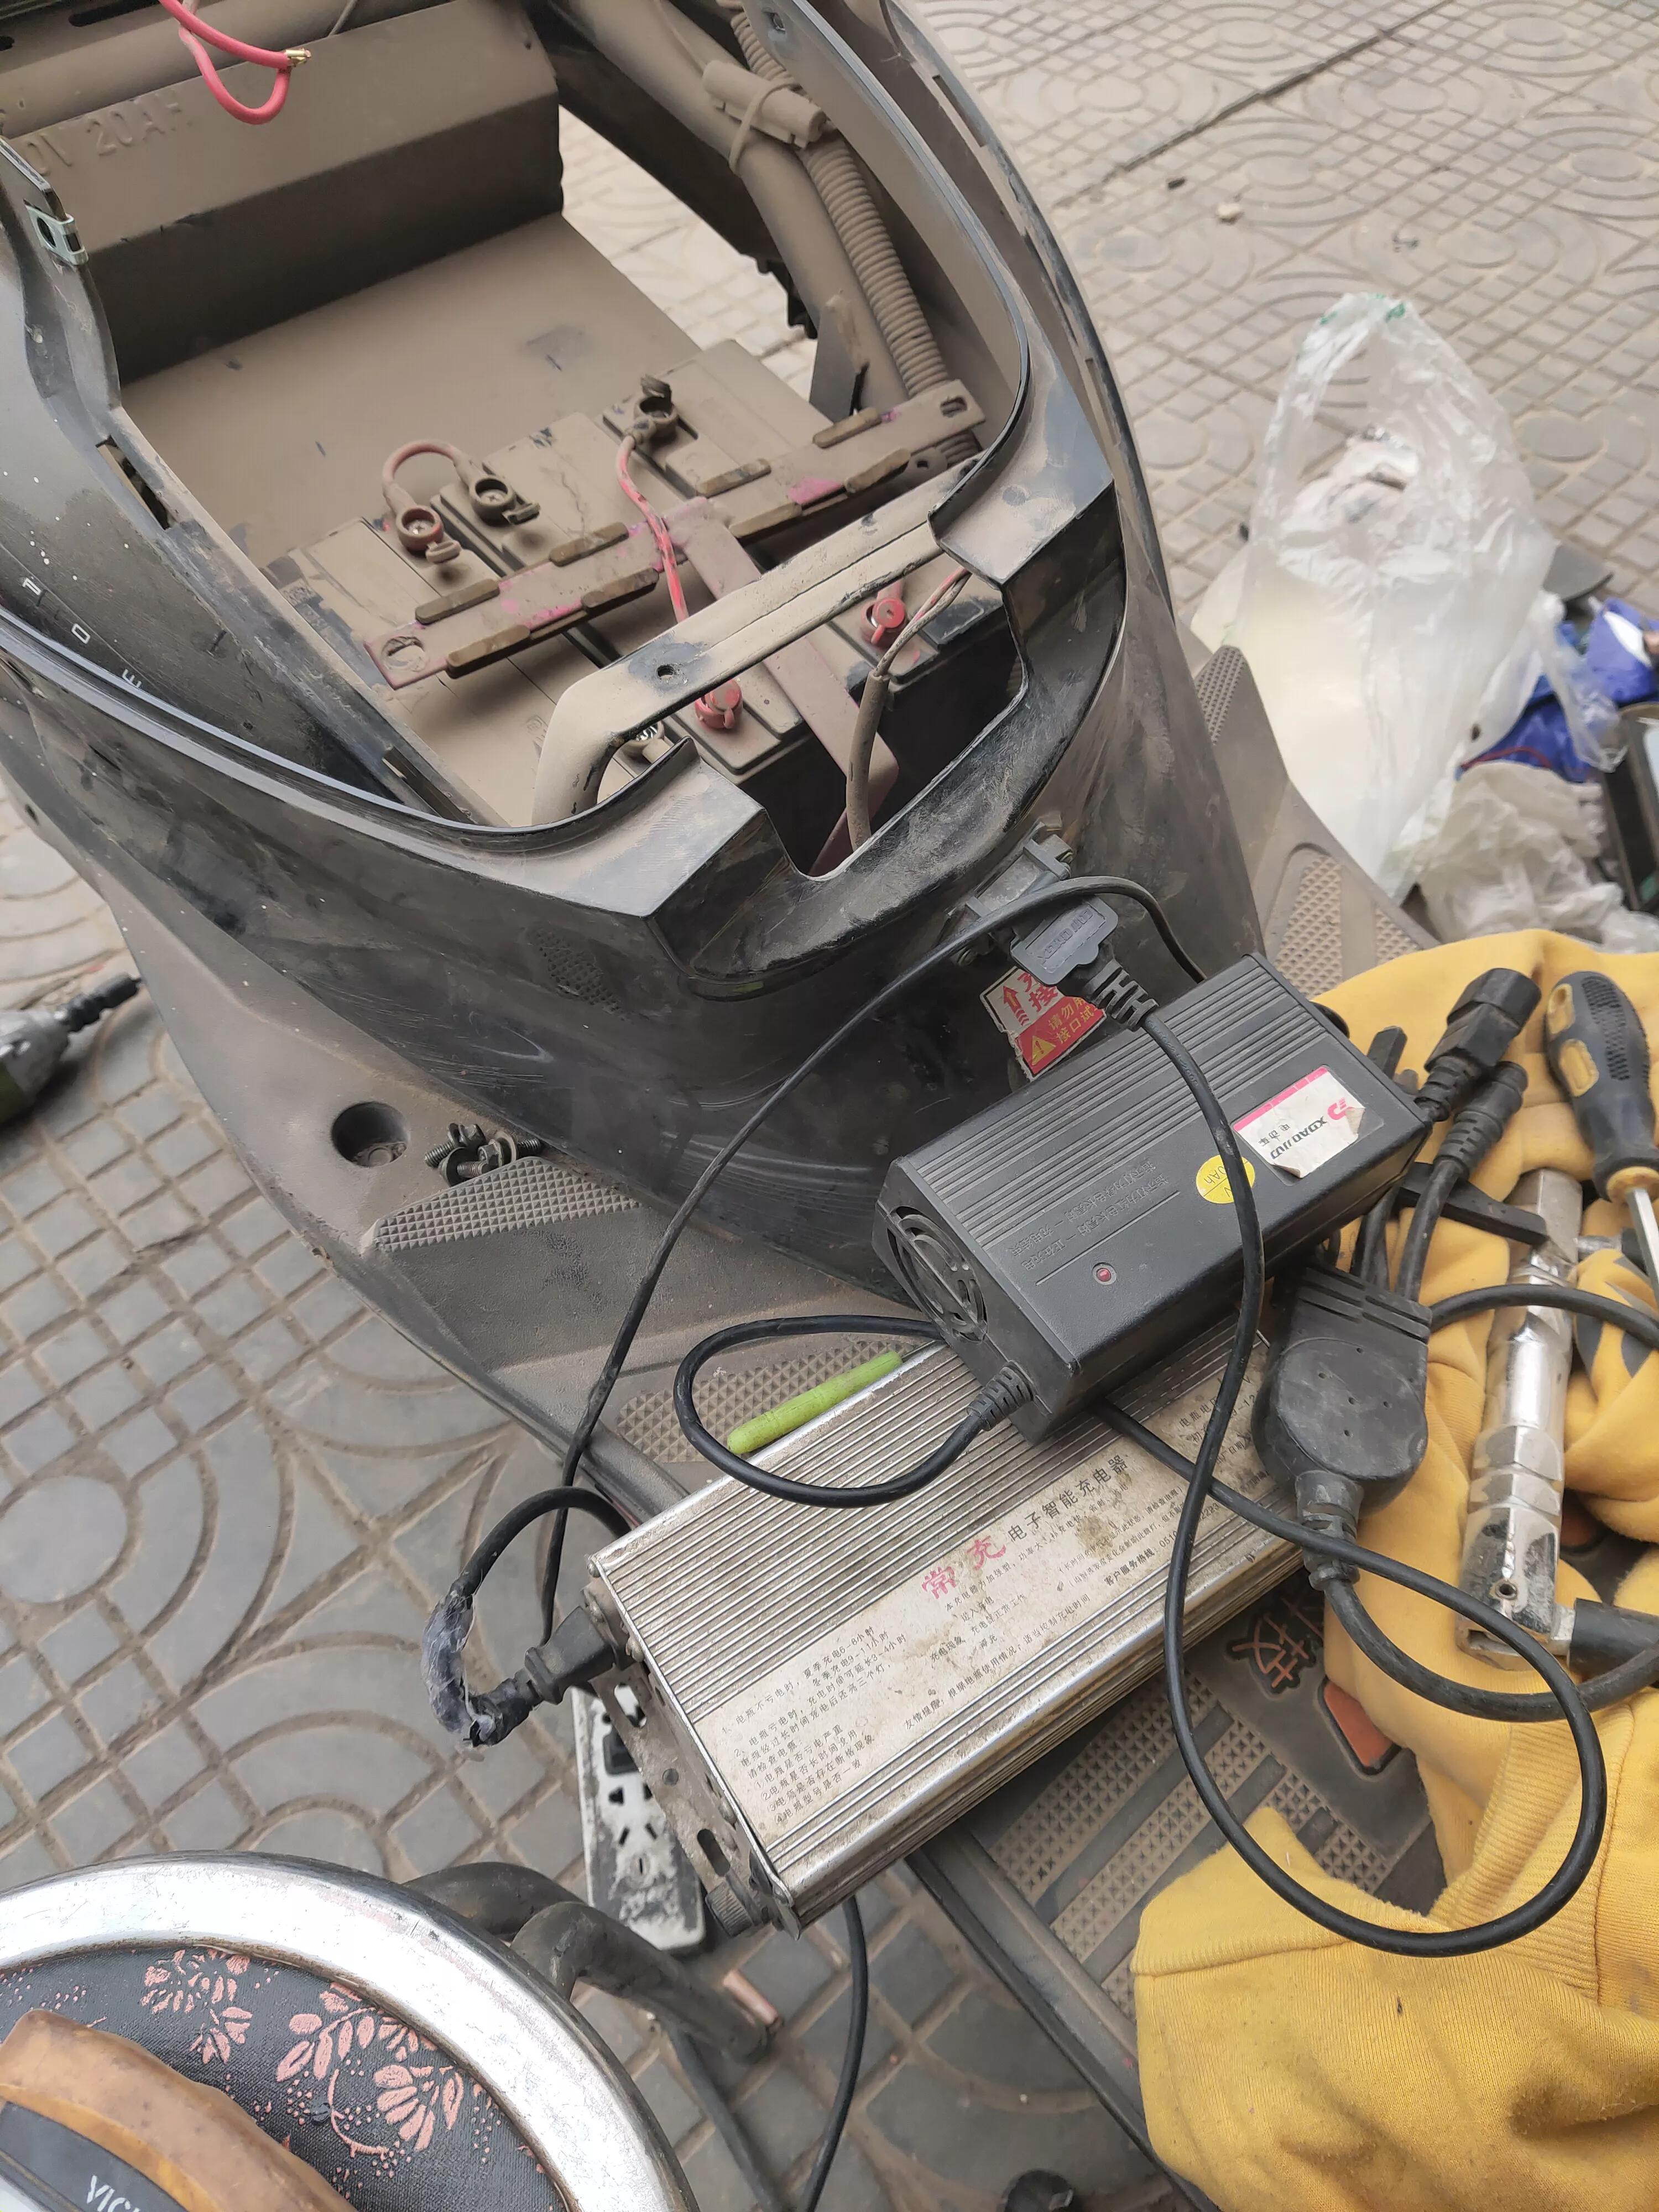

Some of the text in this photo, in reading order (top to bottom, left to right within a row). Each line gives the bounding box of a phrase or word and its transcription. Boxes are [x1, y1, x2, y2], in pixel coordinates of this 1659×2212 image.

[1258, 1122, 1290, 1146] 电动车
[1006, 1454, 1128, 1542] 电子智能充电器
